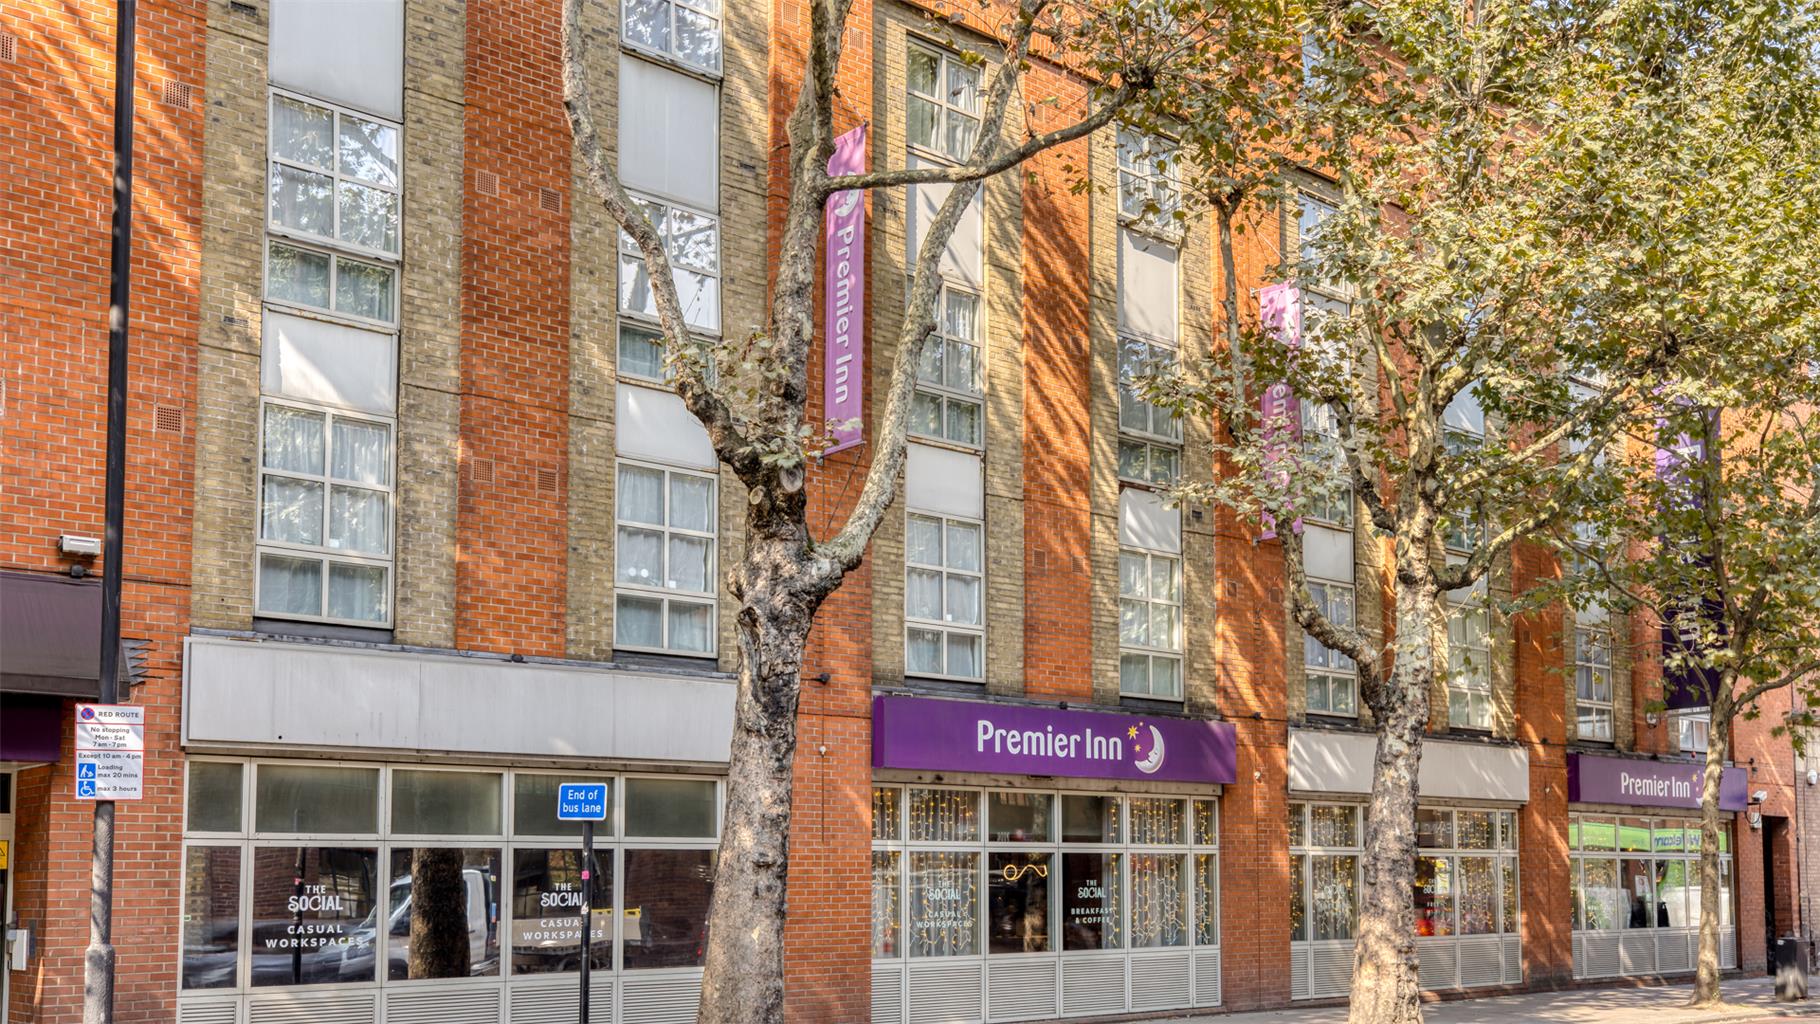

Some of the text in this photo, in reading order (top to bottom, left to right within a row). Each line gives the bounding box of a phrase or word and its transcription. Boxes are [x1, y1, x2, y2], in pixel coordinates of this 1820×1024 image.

[835, 224, 854, 404] Premier Inn
[102, 726, 130, 734] stopping
[977, 719, 1123, 760] Premier Inn
[78, 752, 101, 760] Except
[1620, 771, 1691, 799] Premier Inn
[567, 789, 599, 800] End of
[562, 802, 602, 813] bus lane
[554, 883, 572, 891] THE
[1085, 879, 1097, 887] THE
[305, 884, 326, 894] THE
[928, 888, 961, 901] SOCIAL
[1078, 886, 1107, 899] SOCIAL
[288, 895, 344, 911] SOCIAL
[540, 919, 583, 928] CASUA
[287, 924, 344, 935] CASUAL
[523, 929, 603, 940] WORKSPAES
[265, 936, 364, 949] WORKSPACES
